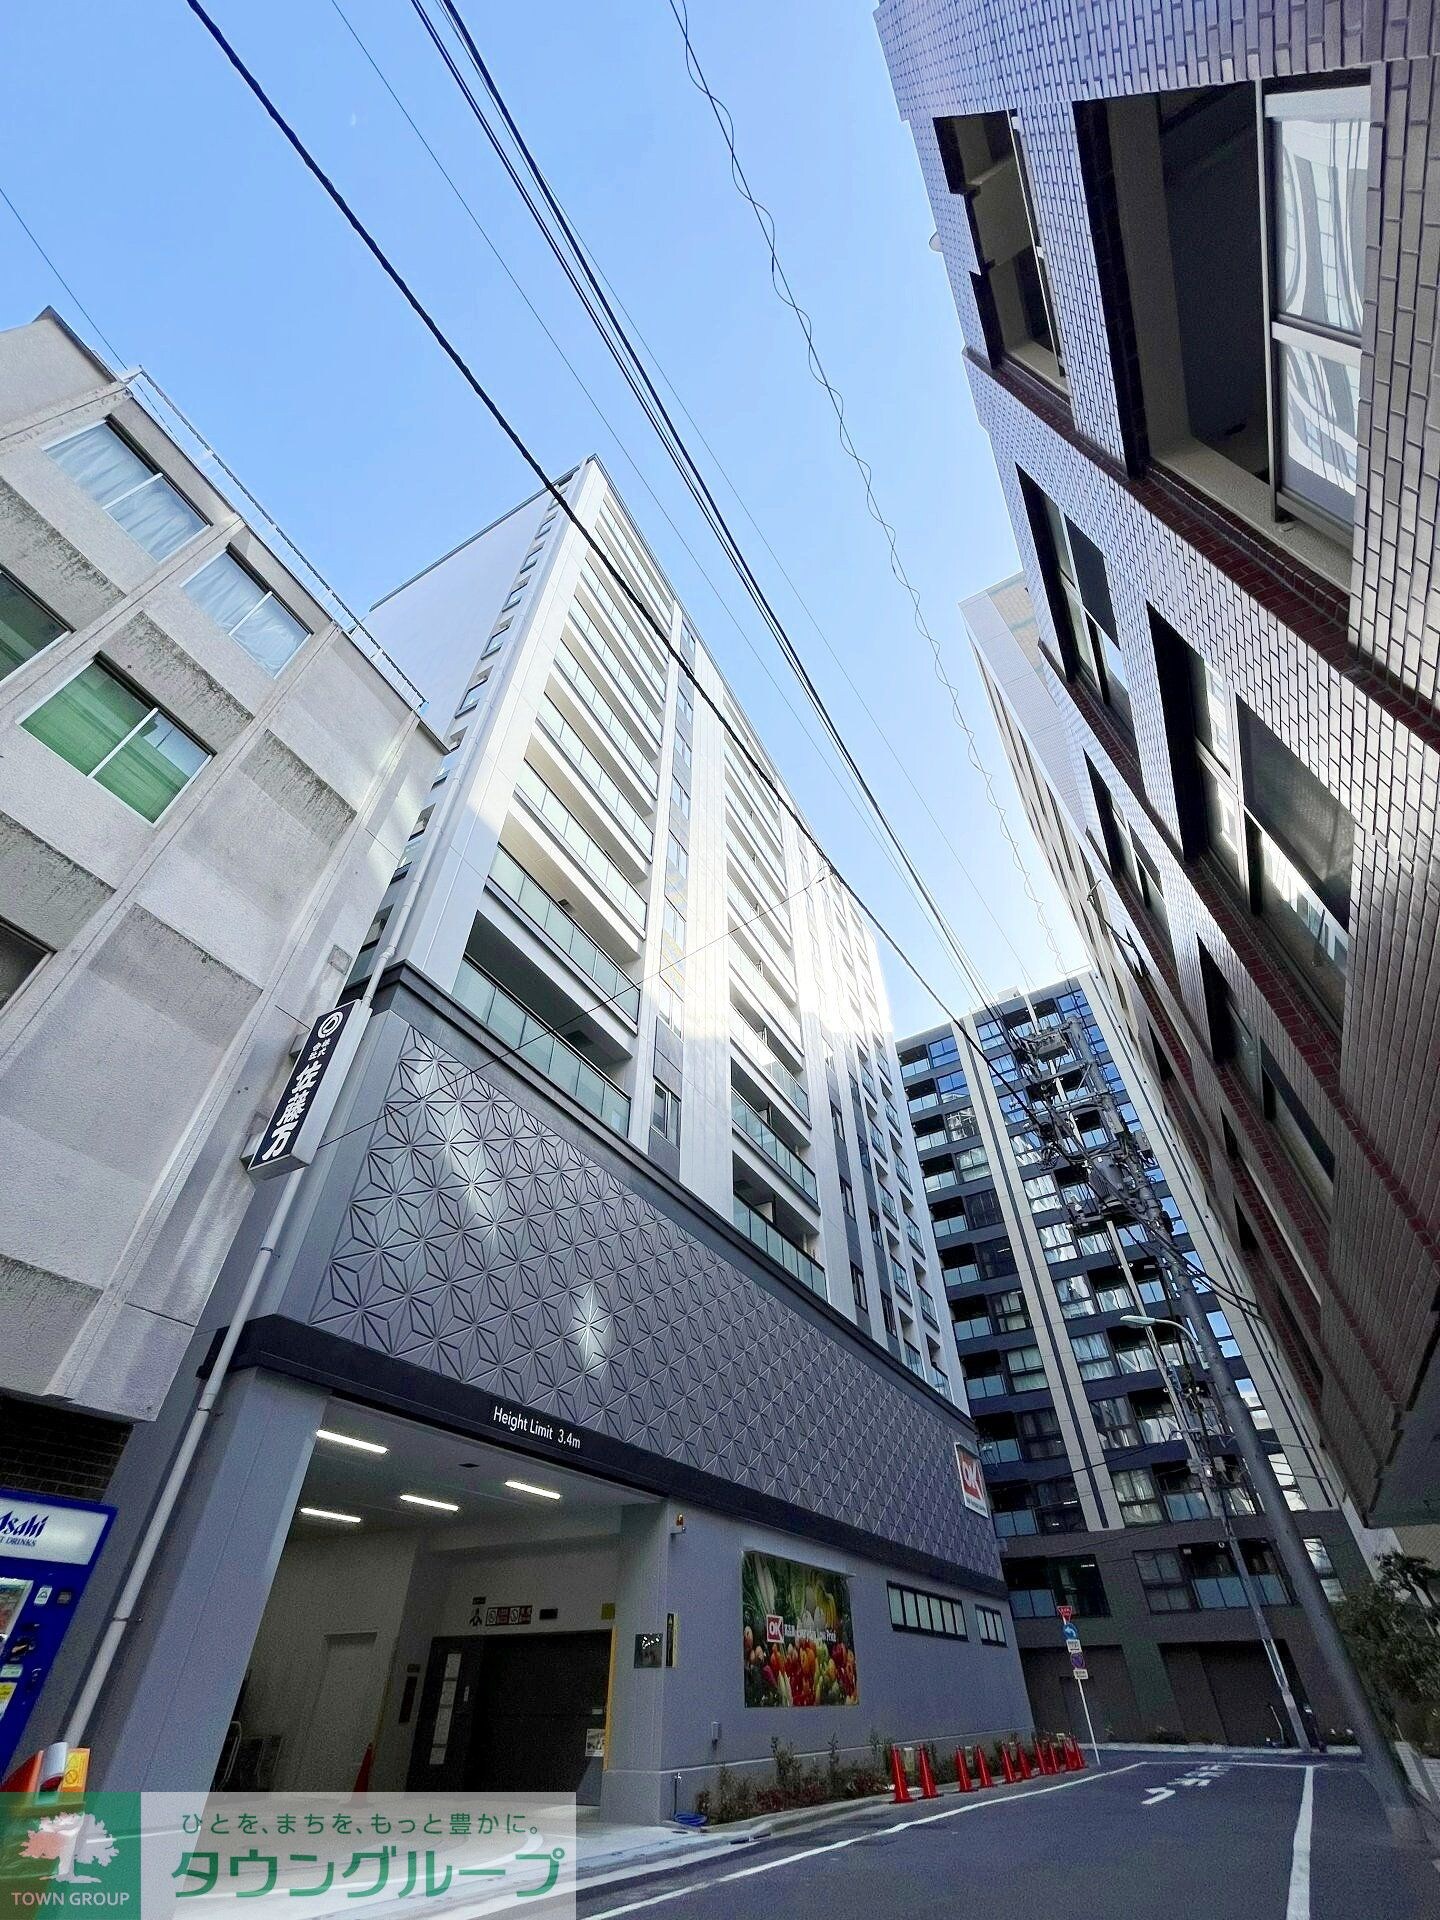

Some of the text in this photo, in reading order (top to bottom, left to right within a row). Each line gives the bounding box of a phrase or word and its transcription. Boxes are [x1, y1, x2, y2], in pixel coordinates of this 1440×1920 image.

[262, 1061, 322, 1161] 佐藤万
[493, 1406, 581, 1449] Height Limit 3.4m
[962, 1460, 984, 1500] OK
[5, 1537, 37, 1547] DRINKS
[769, 1619, 784, 1642] OK
